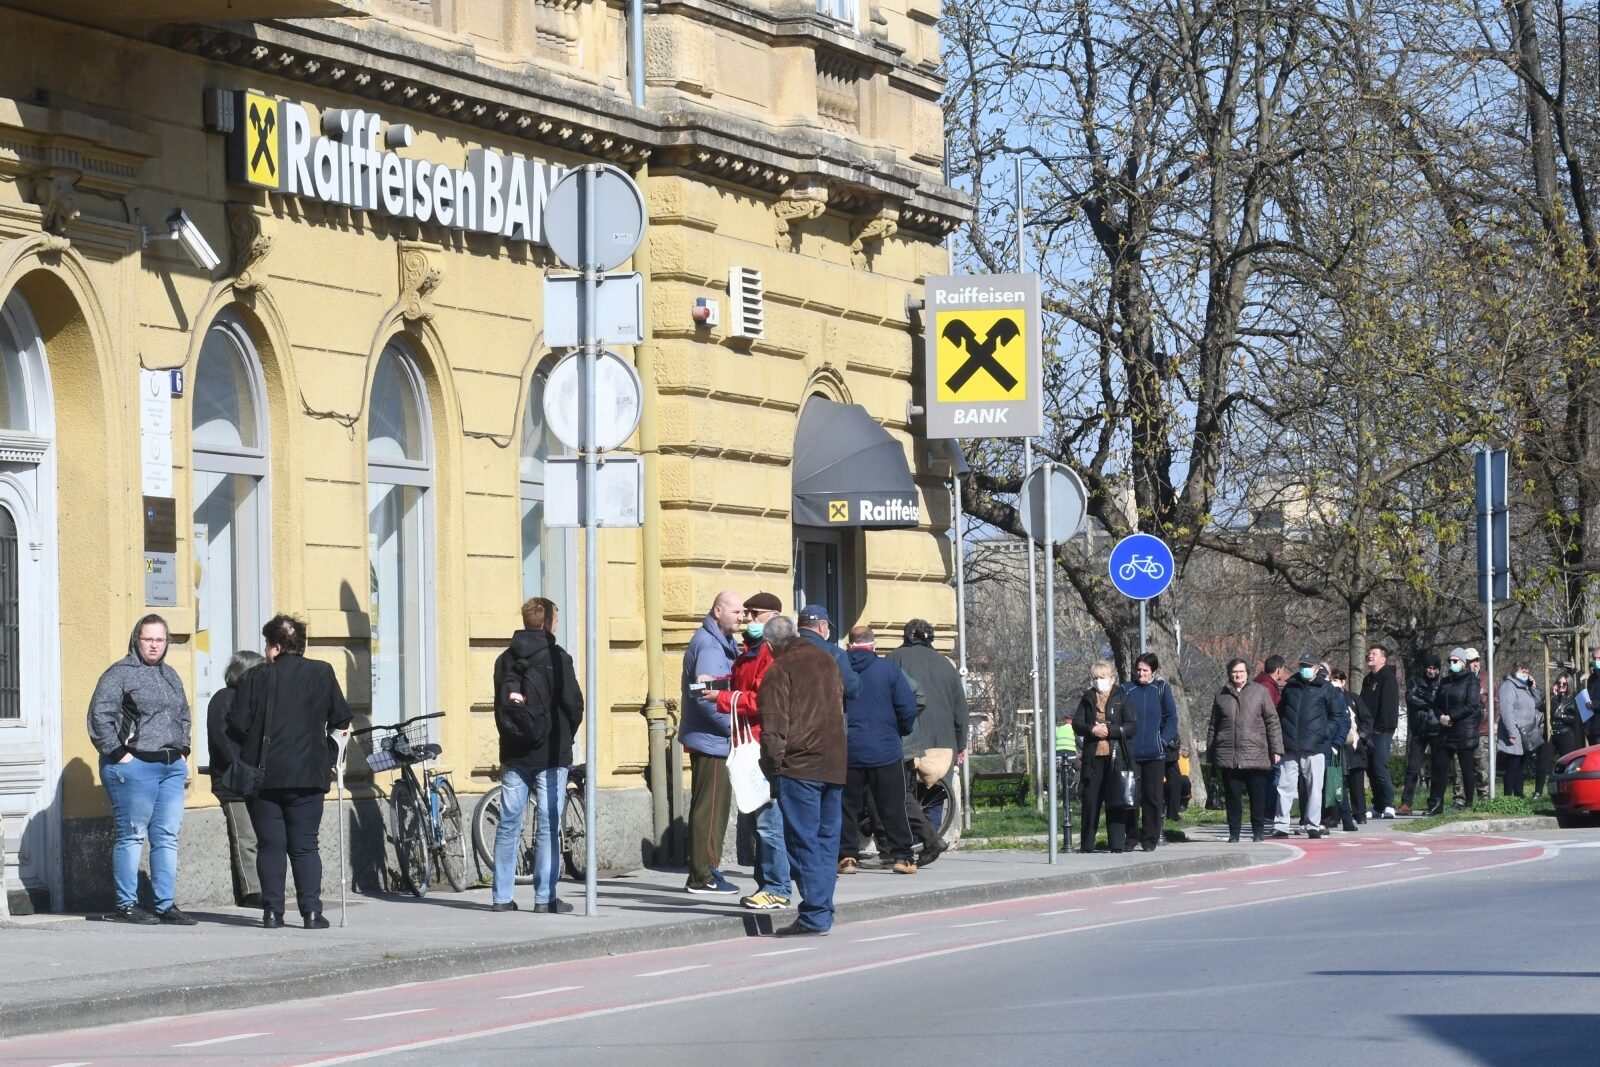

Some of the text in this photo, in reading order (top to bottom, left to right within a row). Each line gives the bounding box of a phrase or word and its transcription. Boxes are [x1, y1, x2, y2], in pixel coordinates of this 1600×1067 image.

[285, 101, 570, 243] Raiffeisen BAN
[935, 287, 1025, 304] Raiffeisen
[176, 372, 182, 392] 6
[953, 407, 1009, 424] BANK
